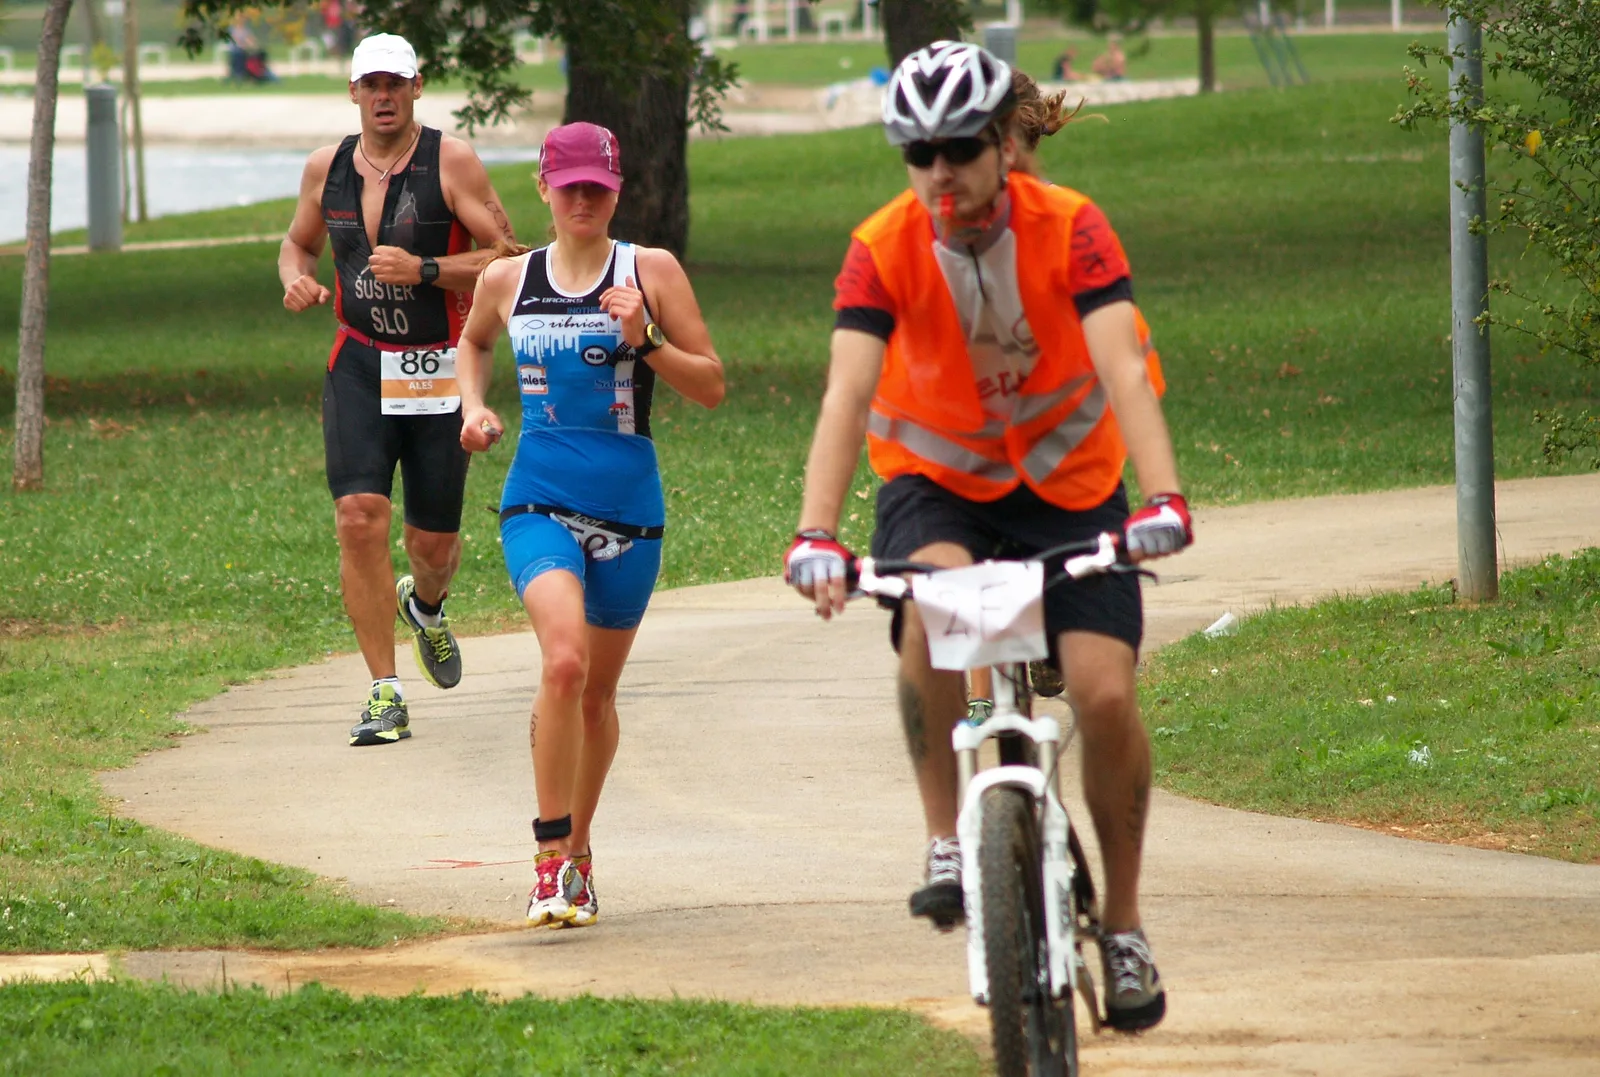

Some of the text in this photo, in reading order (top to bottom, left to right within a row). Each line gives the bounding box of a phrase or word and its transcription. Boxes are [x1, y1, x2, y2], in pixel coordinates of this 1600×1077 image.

[541, 297, 584, 305] BROOKS
[370, 306, 409, 335] SLO
[549, 316, 605, 329] ribnica
[400, 350, 440, 375] 86
[520, 375, 547, 386] inles
